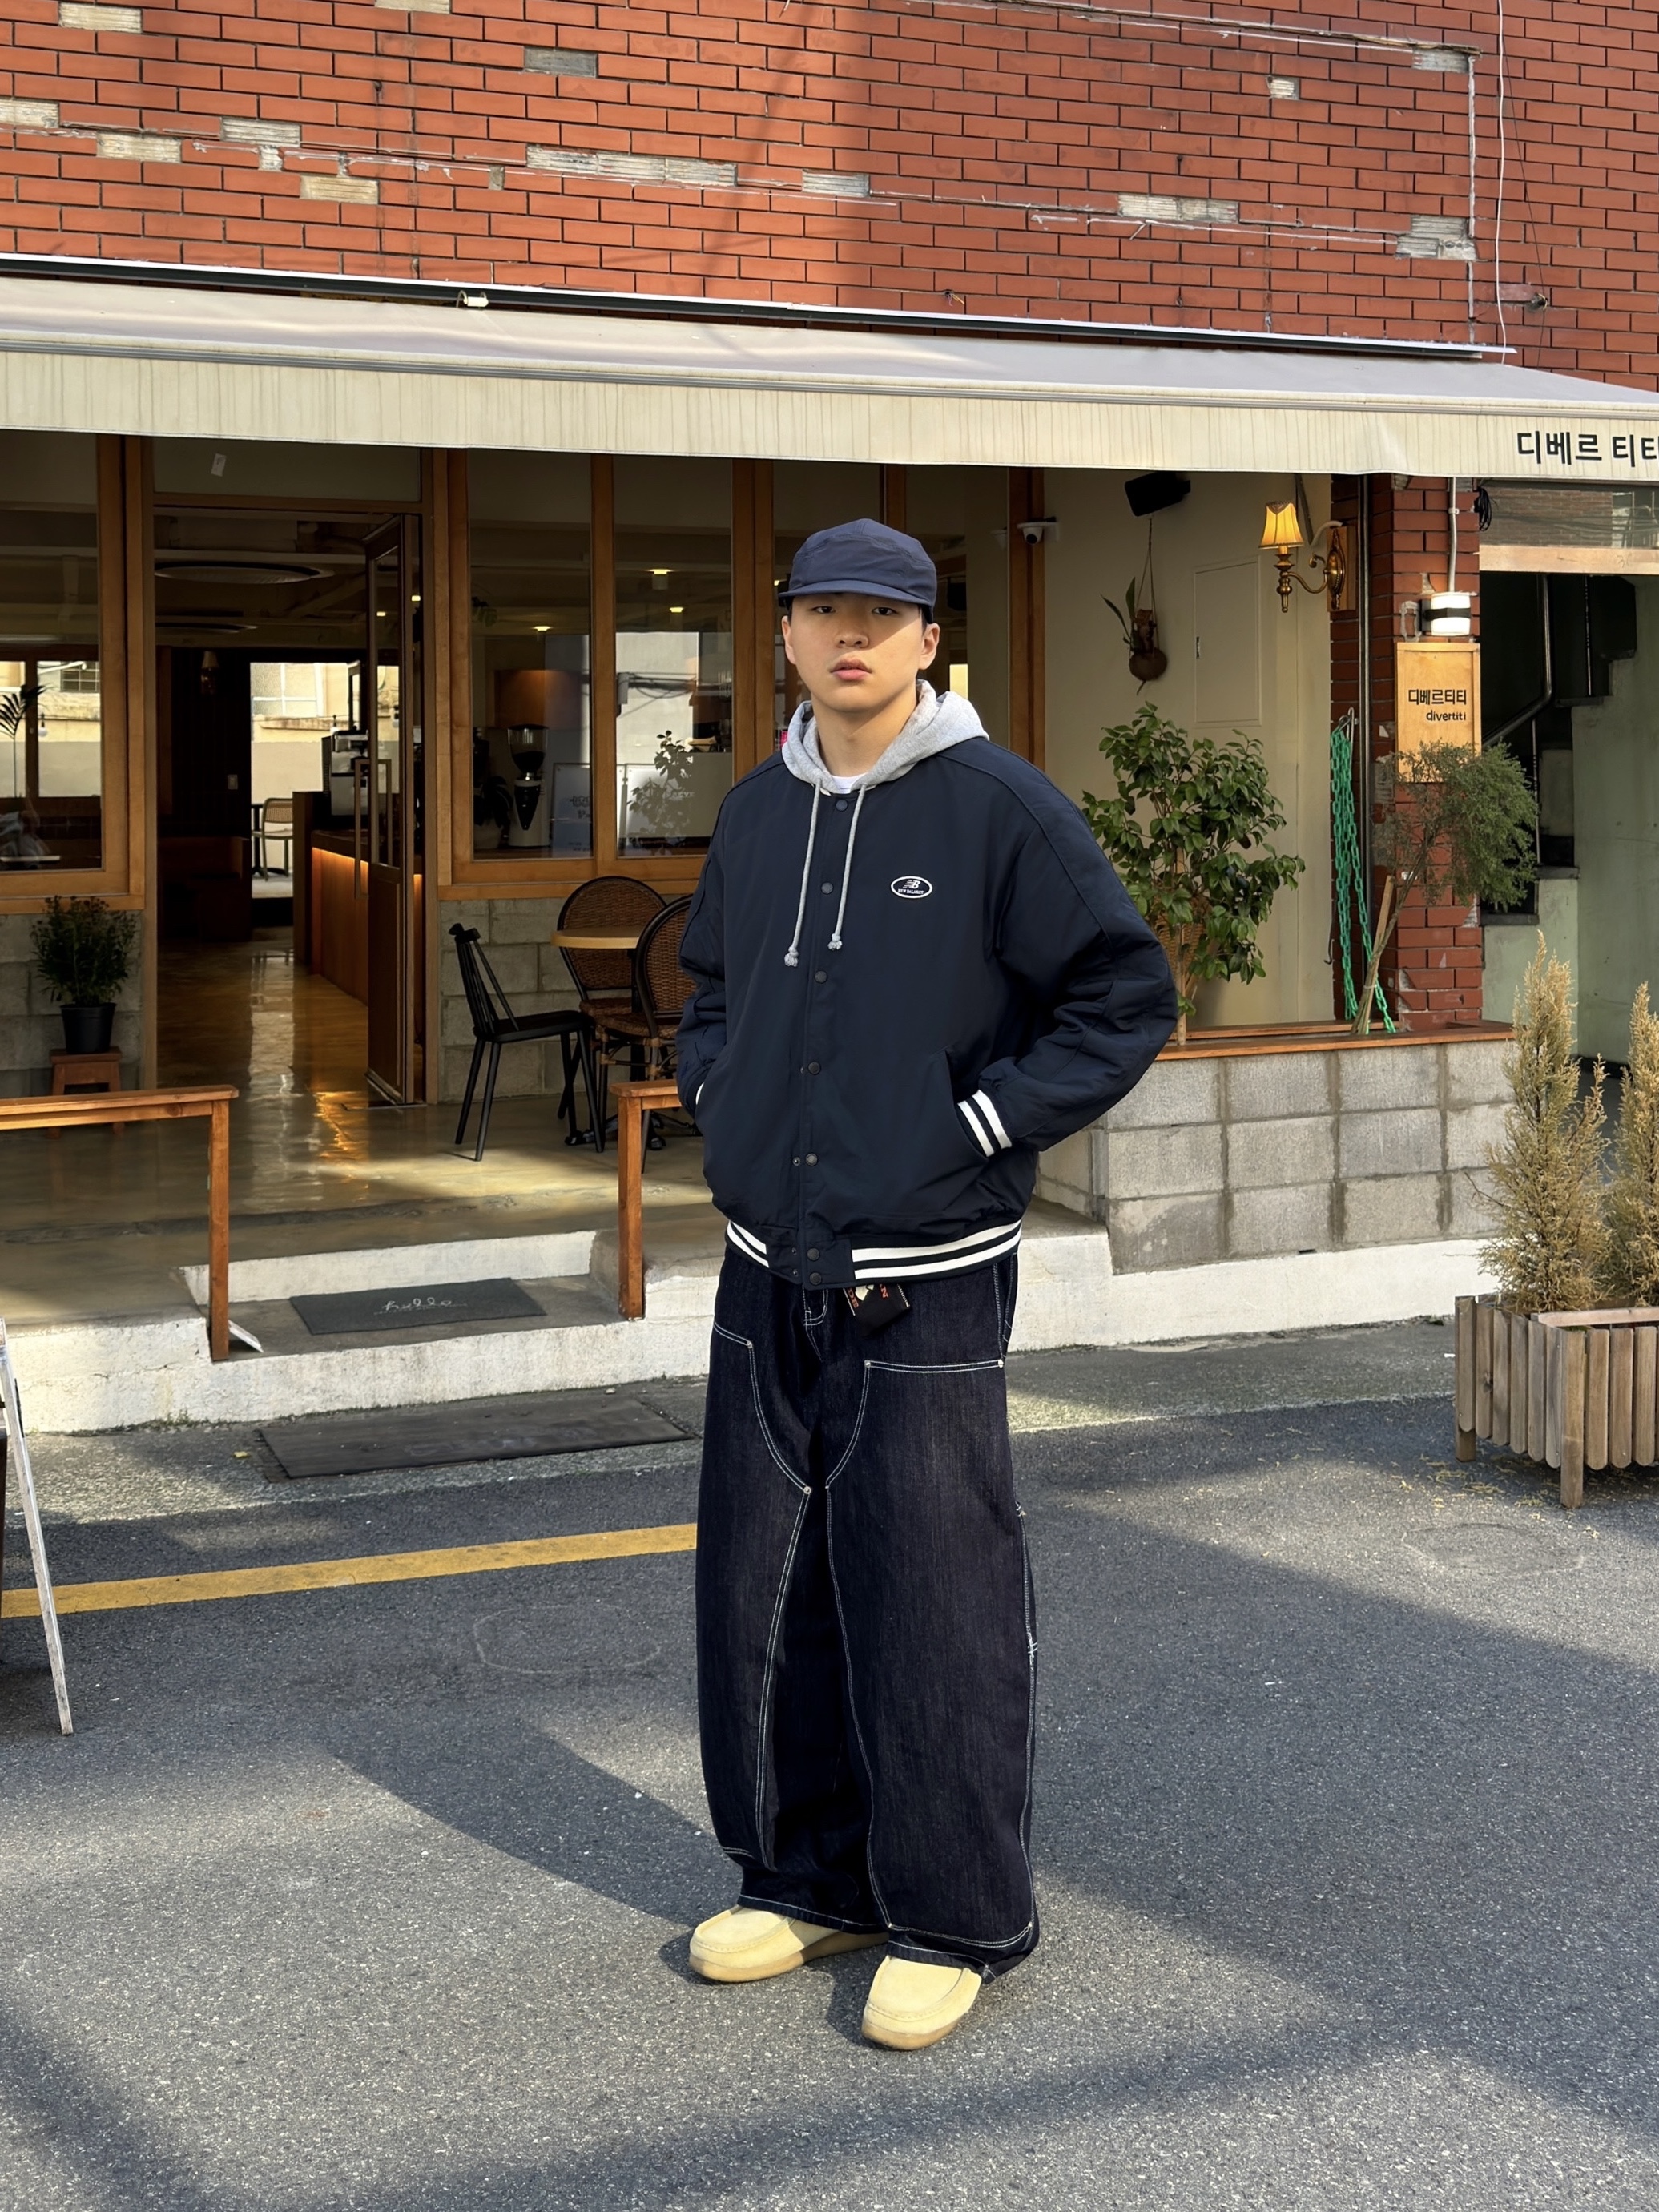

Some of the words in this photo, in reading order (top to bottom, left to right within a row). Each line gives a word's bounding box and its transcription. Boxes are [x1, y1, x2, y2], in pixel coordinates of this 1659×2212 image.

[1517, 431, 1602, 465] 디베르
[1408, 688, 1467, 706] 디베르티티
[1426, 709, 1467, 721] divertiti
